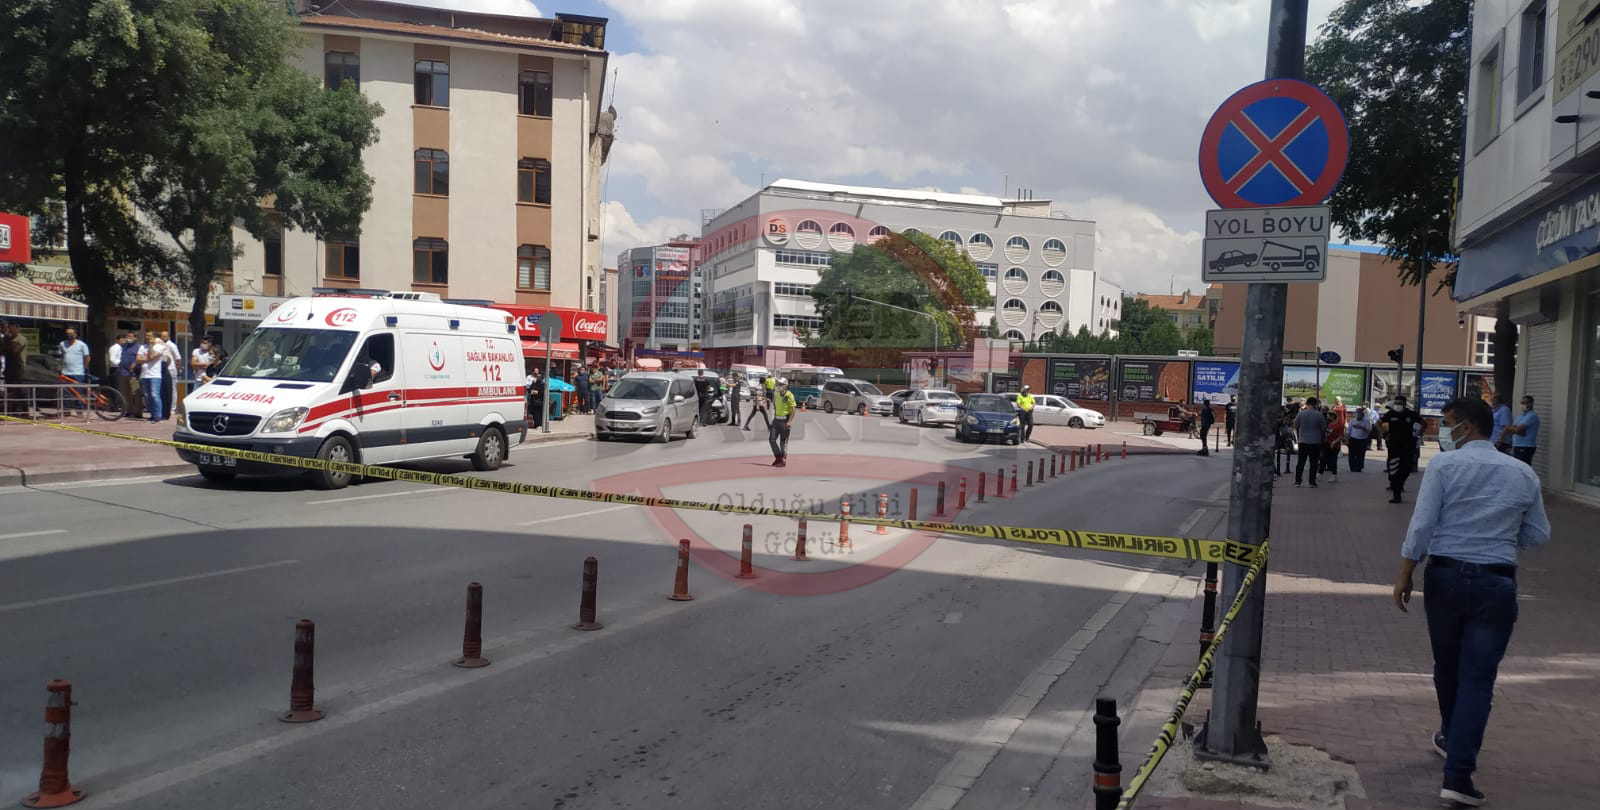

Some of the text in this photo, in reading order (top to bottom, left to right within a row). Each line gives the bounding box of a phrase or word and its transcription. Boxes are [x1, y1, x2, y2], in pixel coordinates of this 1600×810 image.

[769, 223, 787, 233] DS
[1213, 215, 1324, 234] YOL BOYU
[335, 312, 357, 323] 112
[482, 364, 501, 381] 112
